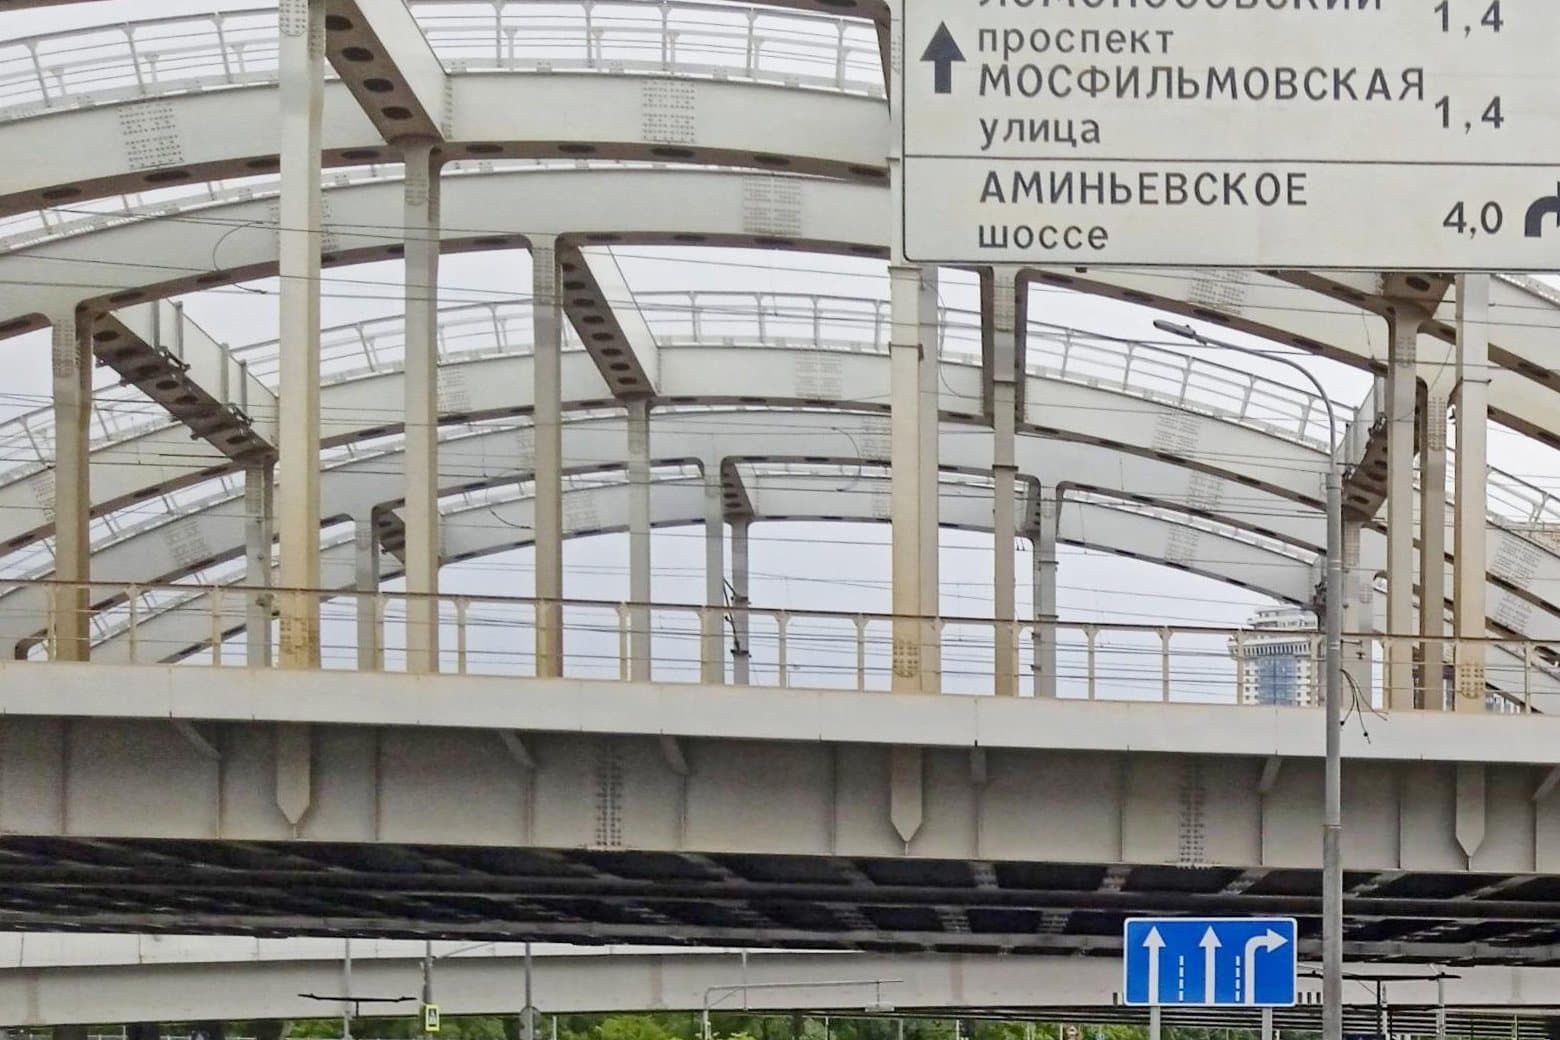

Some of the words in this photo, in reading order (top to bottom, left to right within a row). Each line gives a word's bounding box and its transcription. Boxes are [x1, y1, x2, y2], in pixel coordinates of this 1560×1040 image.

[1434, 0, 1504, 37] 1,4
[979, 27, 1174, 62] проспект
[979, 64, 1424, 101] МОСФИЛЬМОВСКАЯ
[979, 116, 1101, 150] улица
[1434, 96, 1504, 134] 1,4
[979, 171, 1308, 207] АМИНЬЕВСКОЕ
[979, 224, 1109, 250] шоссе
[1443, 201, 1503, 239] 4,0
